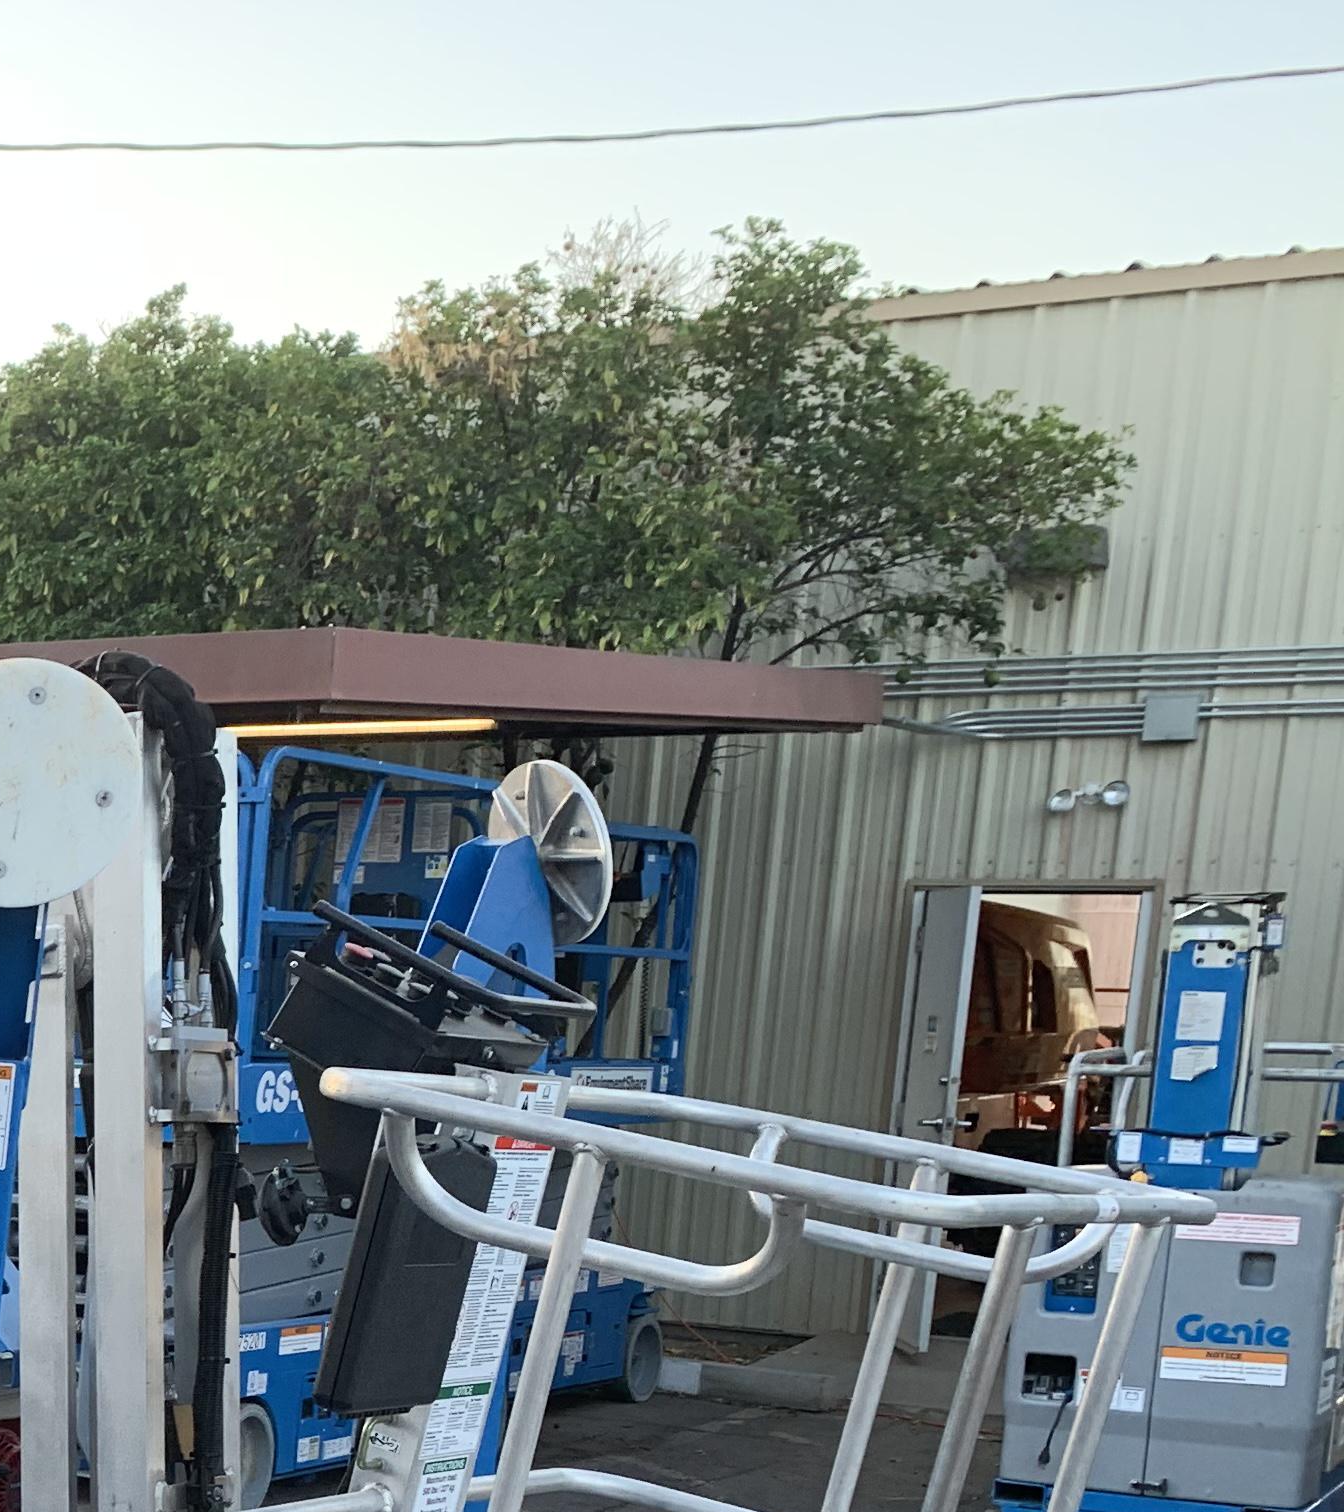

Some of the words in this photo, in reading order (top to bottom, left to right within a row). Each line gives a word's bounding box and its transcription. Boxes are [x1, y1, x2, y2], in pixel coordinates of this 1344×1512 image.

[1175, 1313, 1291, 1348] Genie
[1205, 1351, 1243, 1361] NOTICE
[452, 1385, 474, 1397] NOTICE
